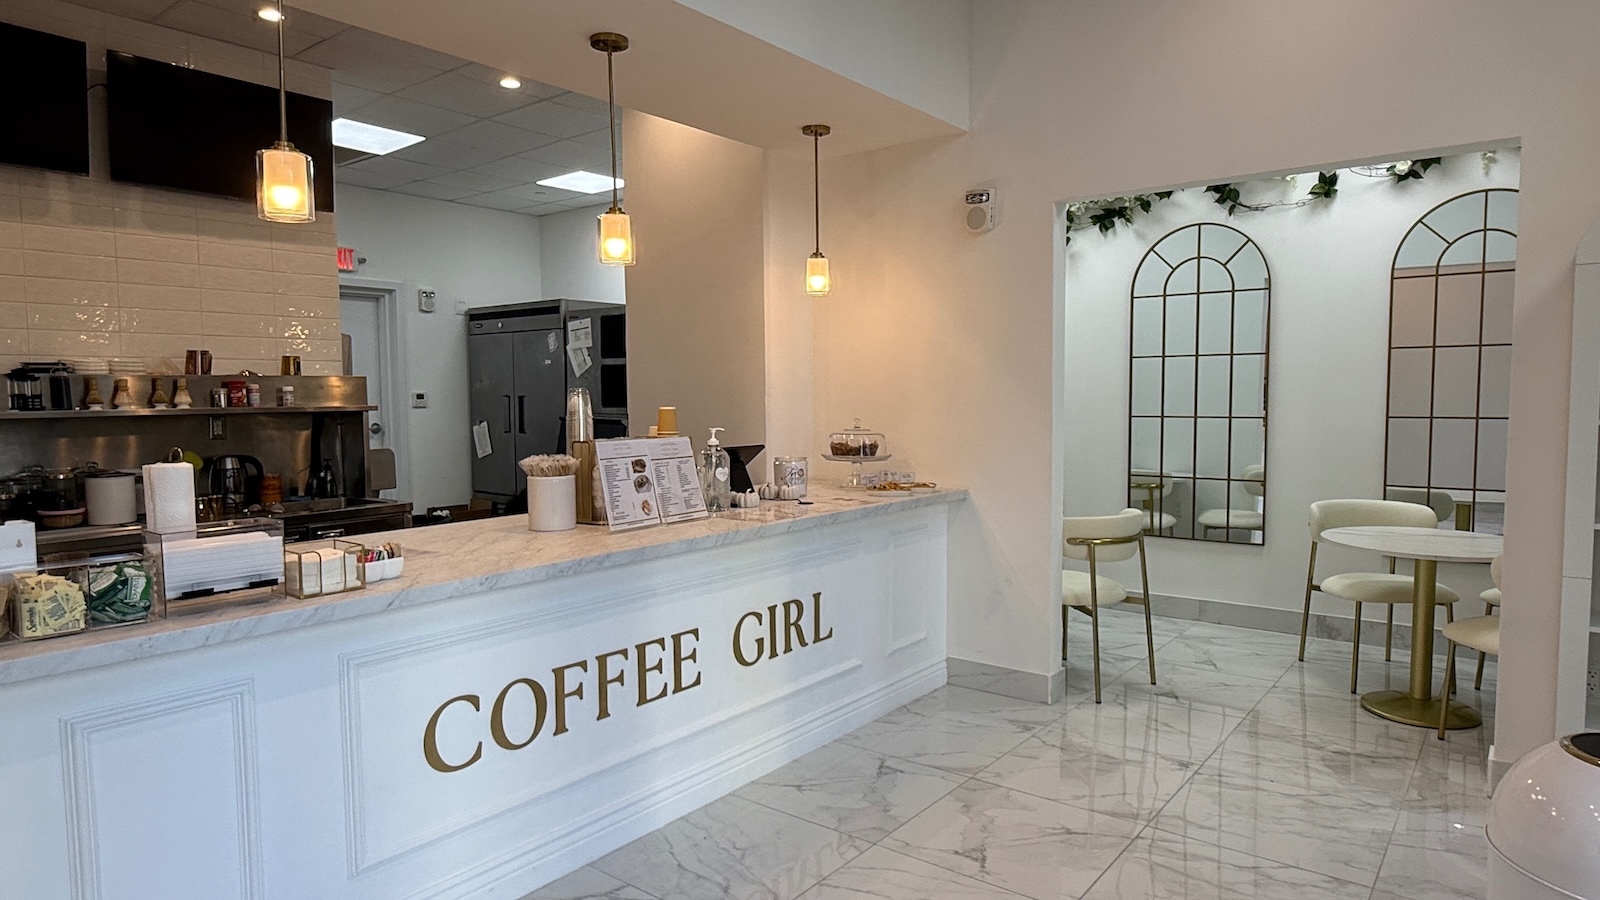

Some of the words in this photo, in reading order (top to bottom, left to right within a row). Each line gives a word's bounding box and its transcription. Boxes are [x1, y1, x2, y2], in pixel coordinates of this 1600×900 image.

[337, 248, 354, 269] XIT
[423, 627, 701, 773] COFFEE
[732, 591, 833, 667] GIRL
